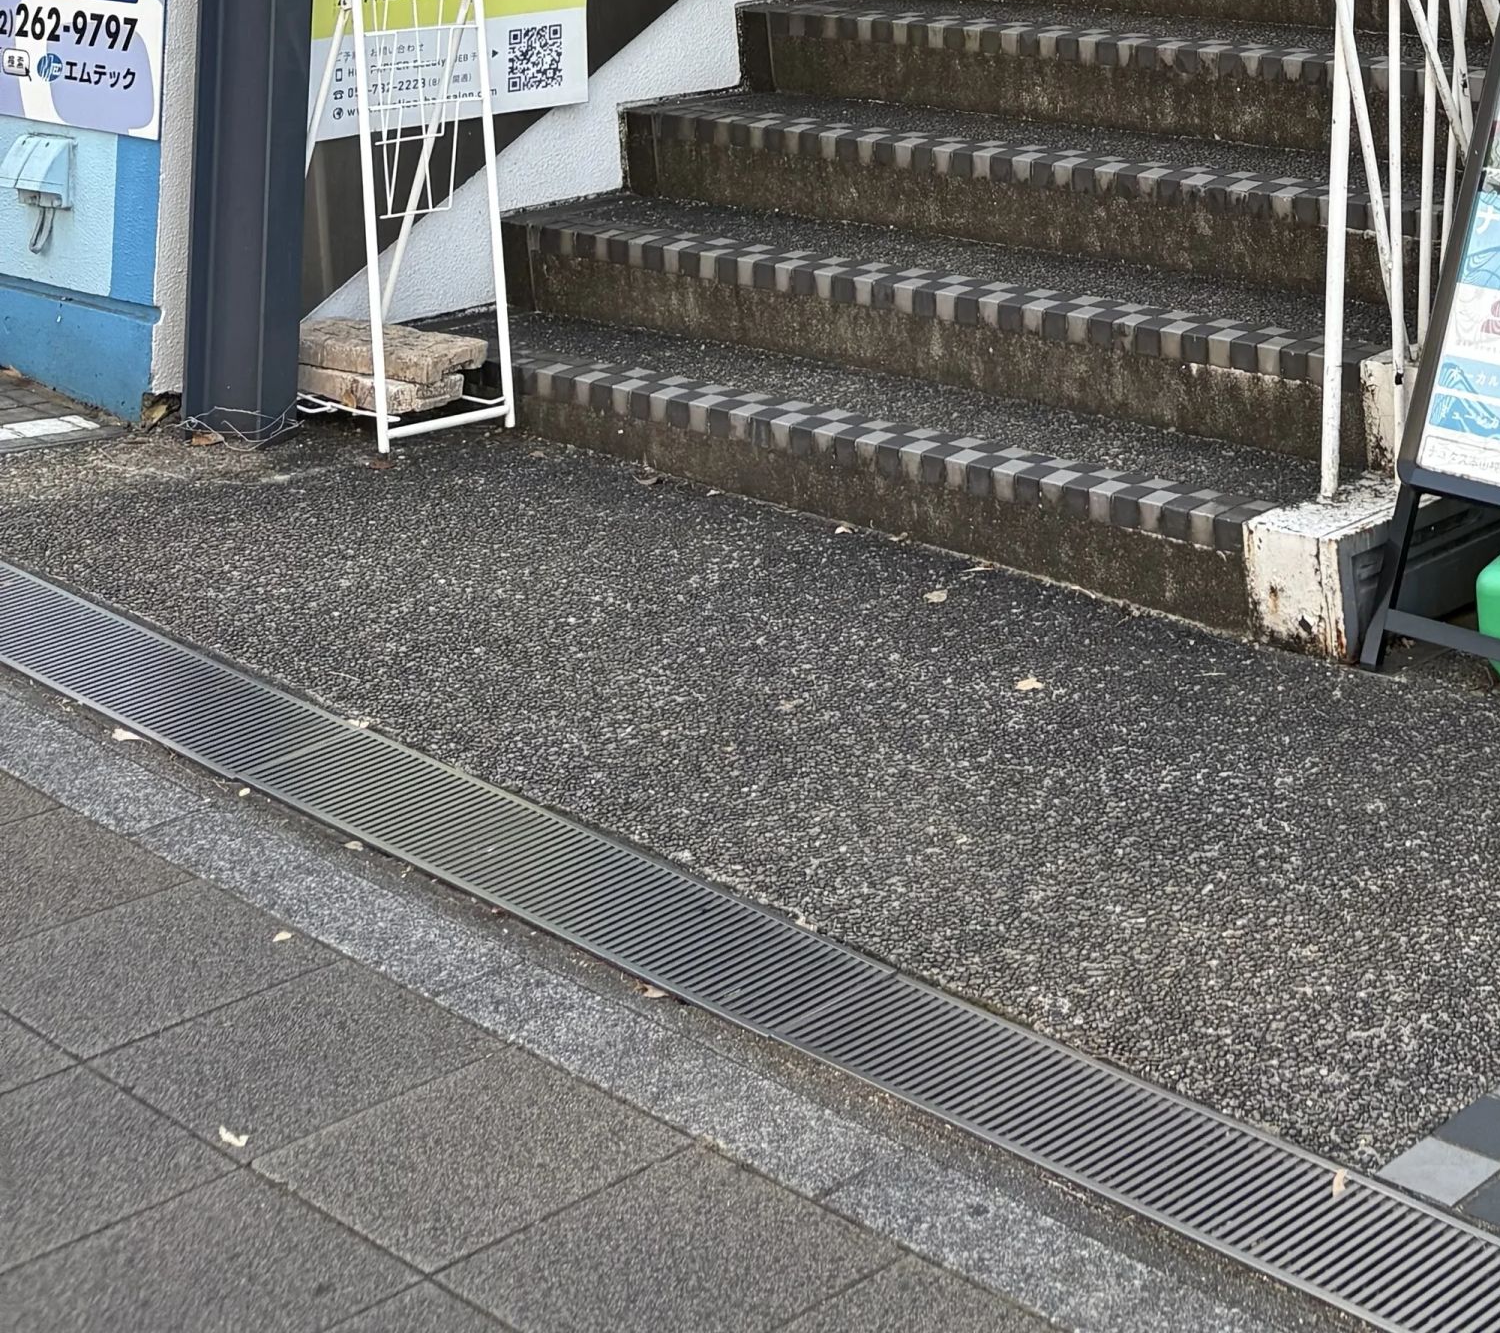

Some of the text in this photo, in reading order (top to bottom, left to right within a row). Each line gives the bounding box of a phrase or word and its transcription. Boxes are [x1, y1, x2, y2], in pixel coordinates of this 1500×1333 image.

[64, 60, 137, 90] エムテック
